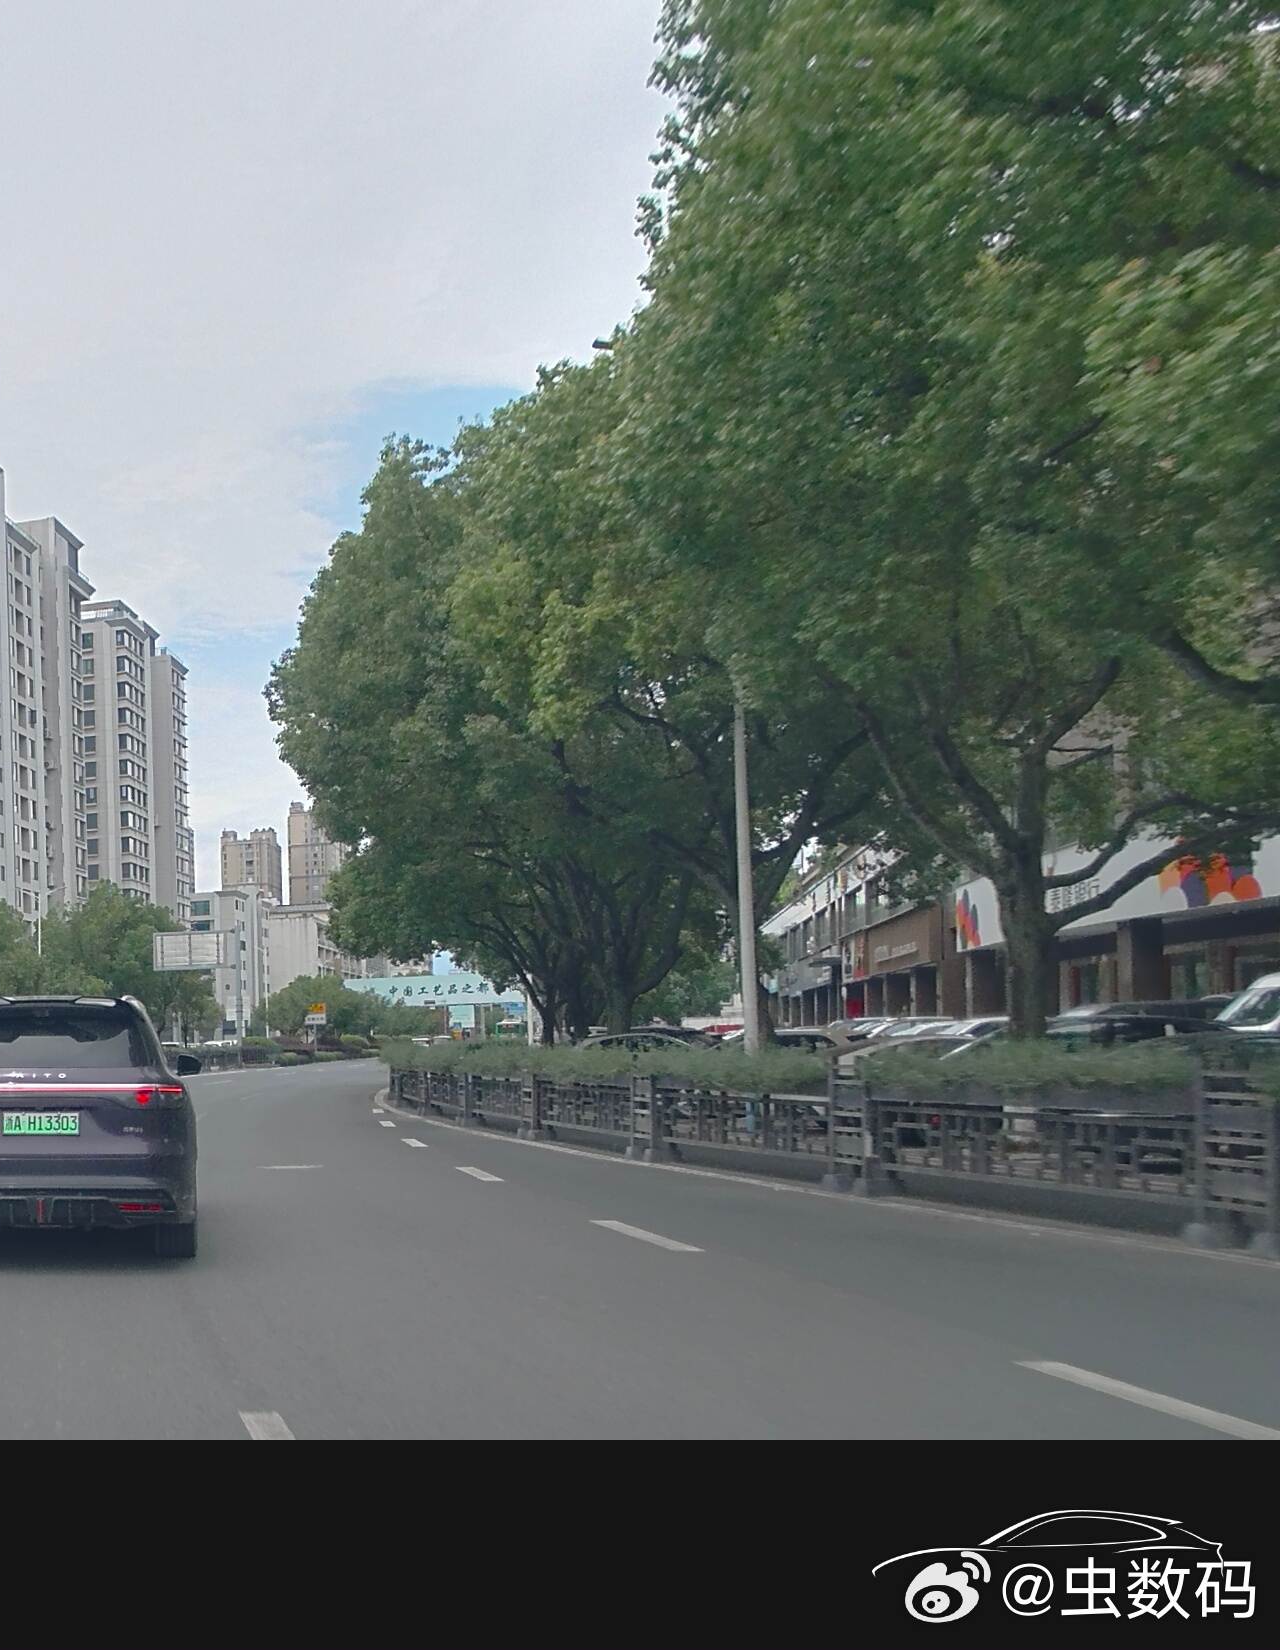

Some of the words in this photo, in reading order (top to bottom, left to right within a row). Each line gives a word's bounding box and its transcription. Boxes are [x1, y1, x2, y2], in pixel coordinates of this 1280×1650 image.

[389, 981, 490, 997] 中国工艺品之都
